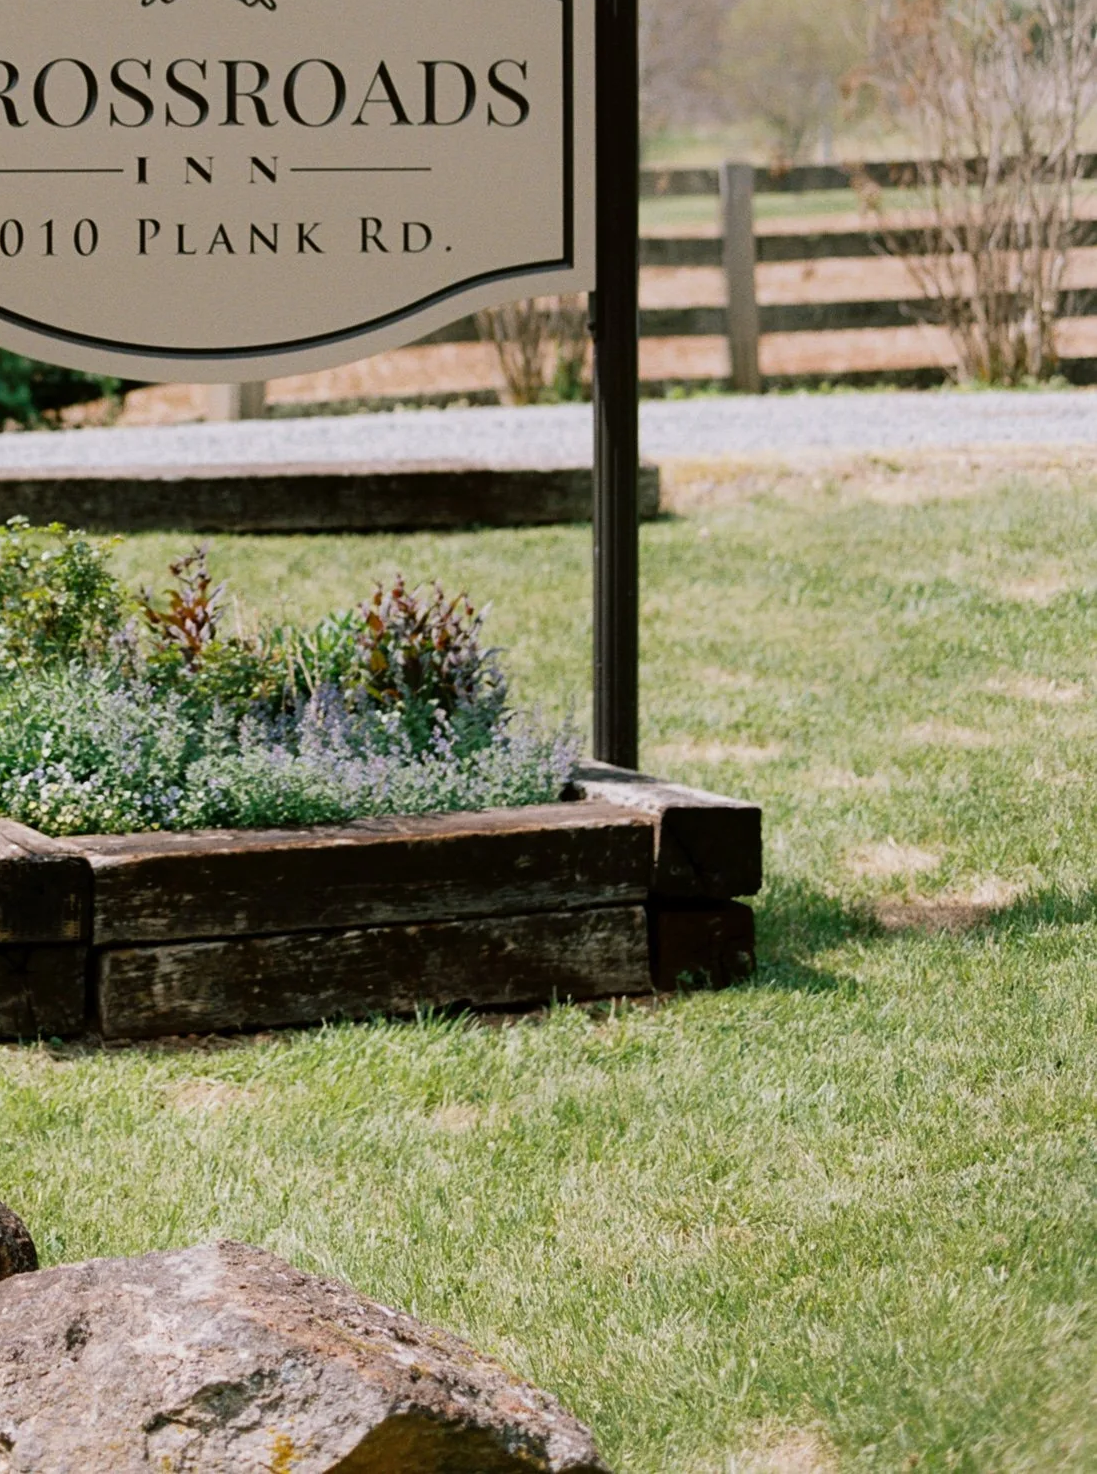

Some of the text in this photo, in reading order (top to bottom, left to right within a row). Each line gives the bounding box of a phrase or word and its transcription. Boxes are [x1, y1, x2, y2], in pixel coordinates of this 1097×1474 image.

[135, 155, 278, 185] INN
[136, 218, 326, 256] PLANK
[359, 216, 453, 254] RD.
